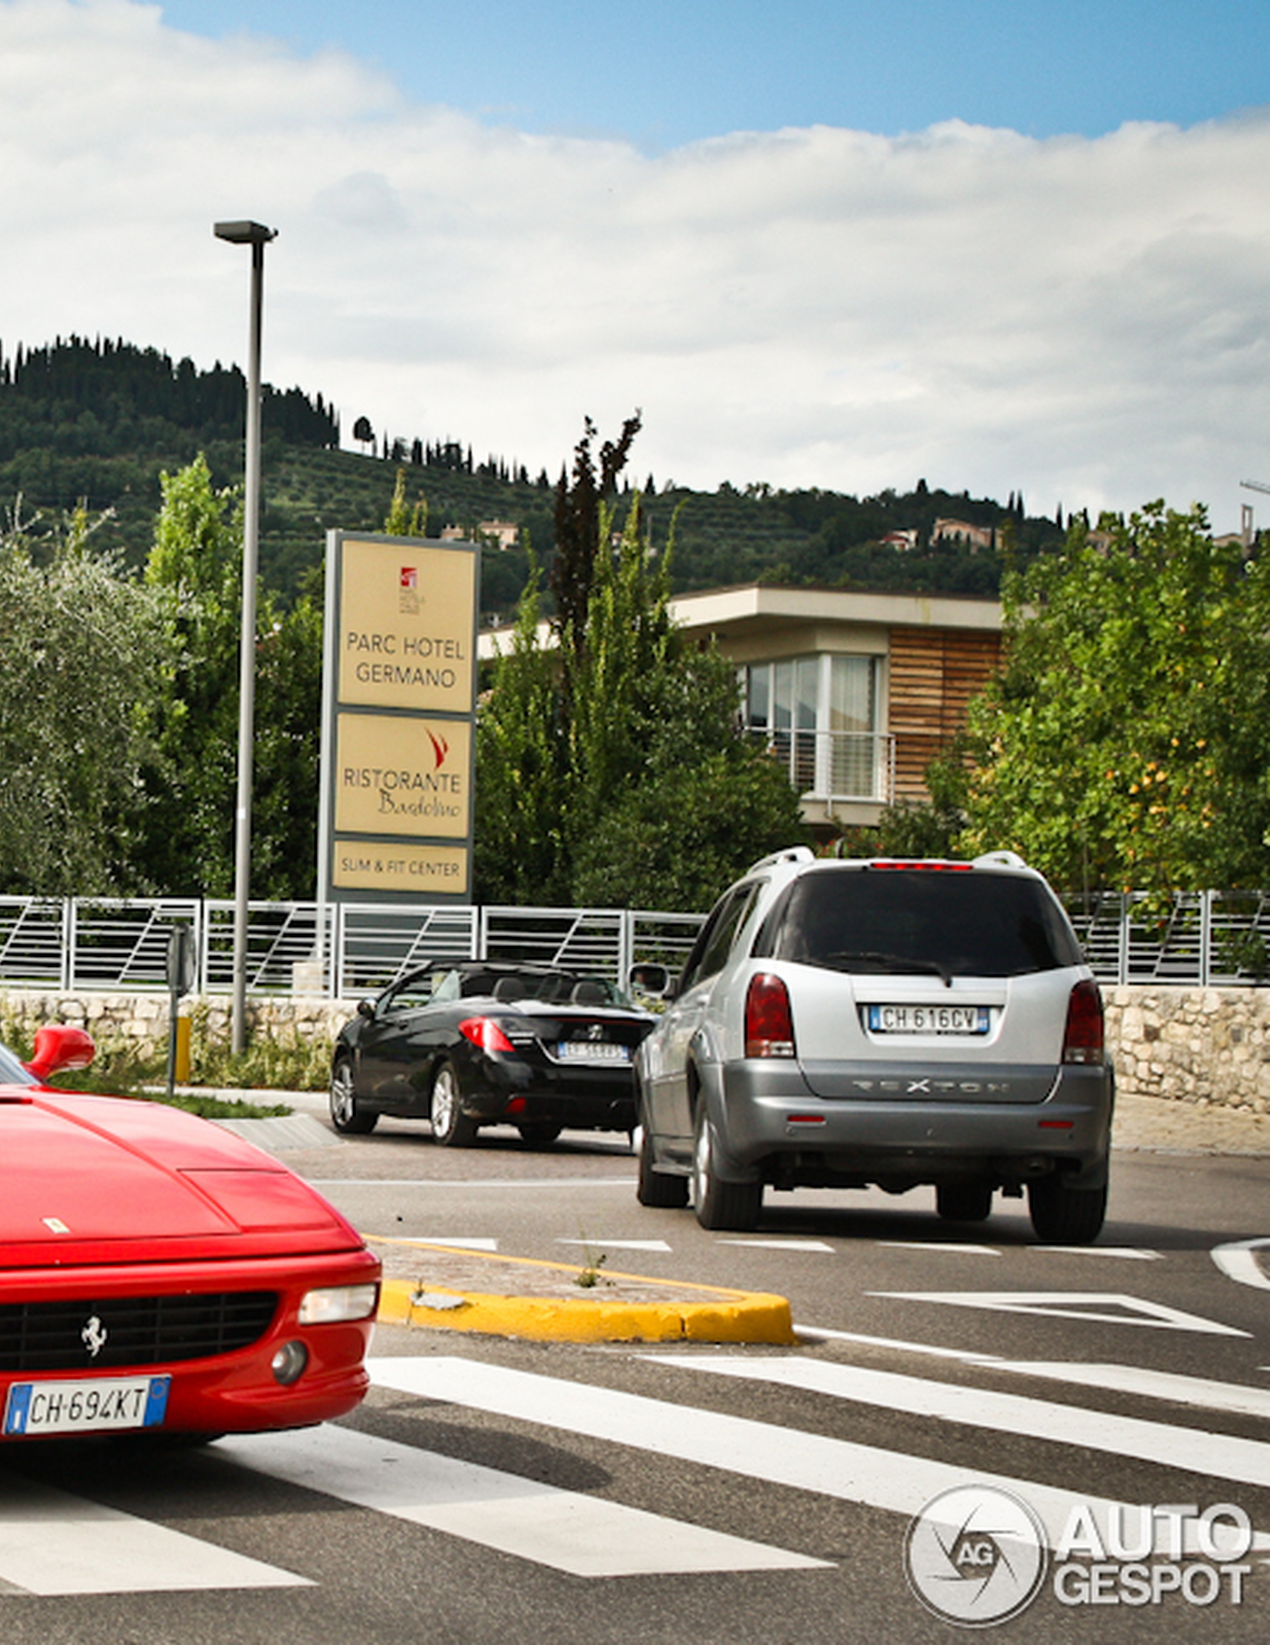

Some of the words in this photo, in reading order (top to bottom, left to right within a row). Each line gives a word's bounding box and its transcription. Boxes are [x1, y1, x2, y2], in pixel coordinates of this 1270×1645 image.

[347, 632, 396, 654] PARC
[403, 637, 464, 660] HOTEL
[356, 662, 456, 688] GERMANO
[343, 766, 462, 794] RISTORANTE
[341, 858, 372, 872] SLIM
[374, 860, 383, 874] &
[387, 861, 406, 874] FIT
[409, 861, 460, 877] CENTER
